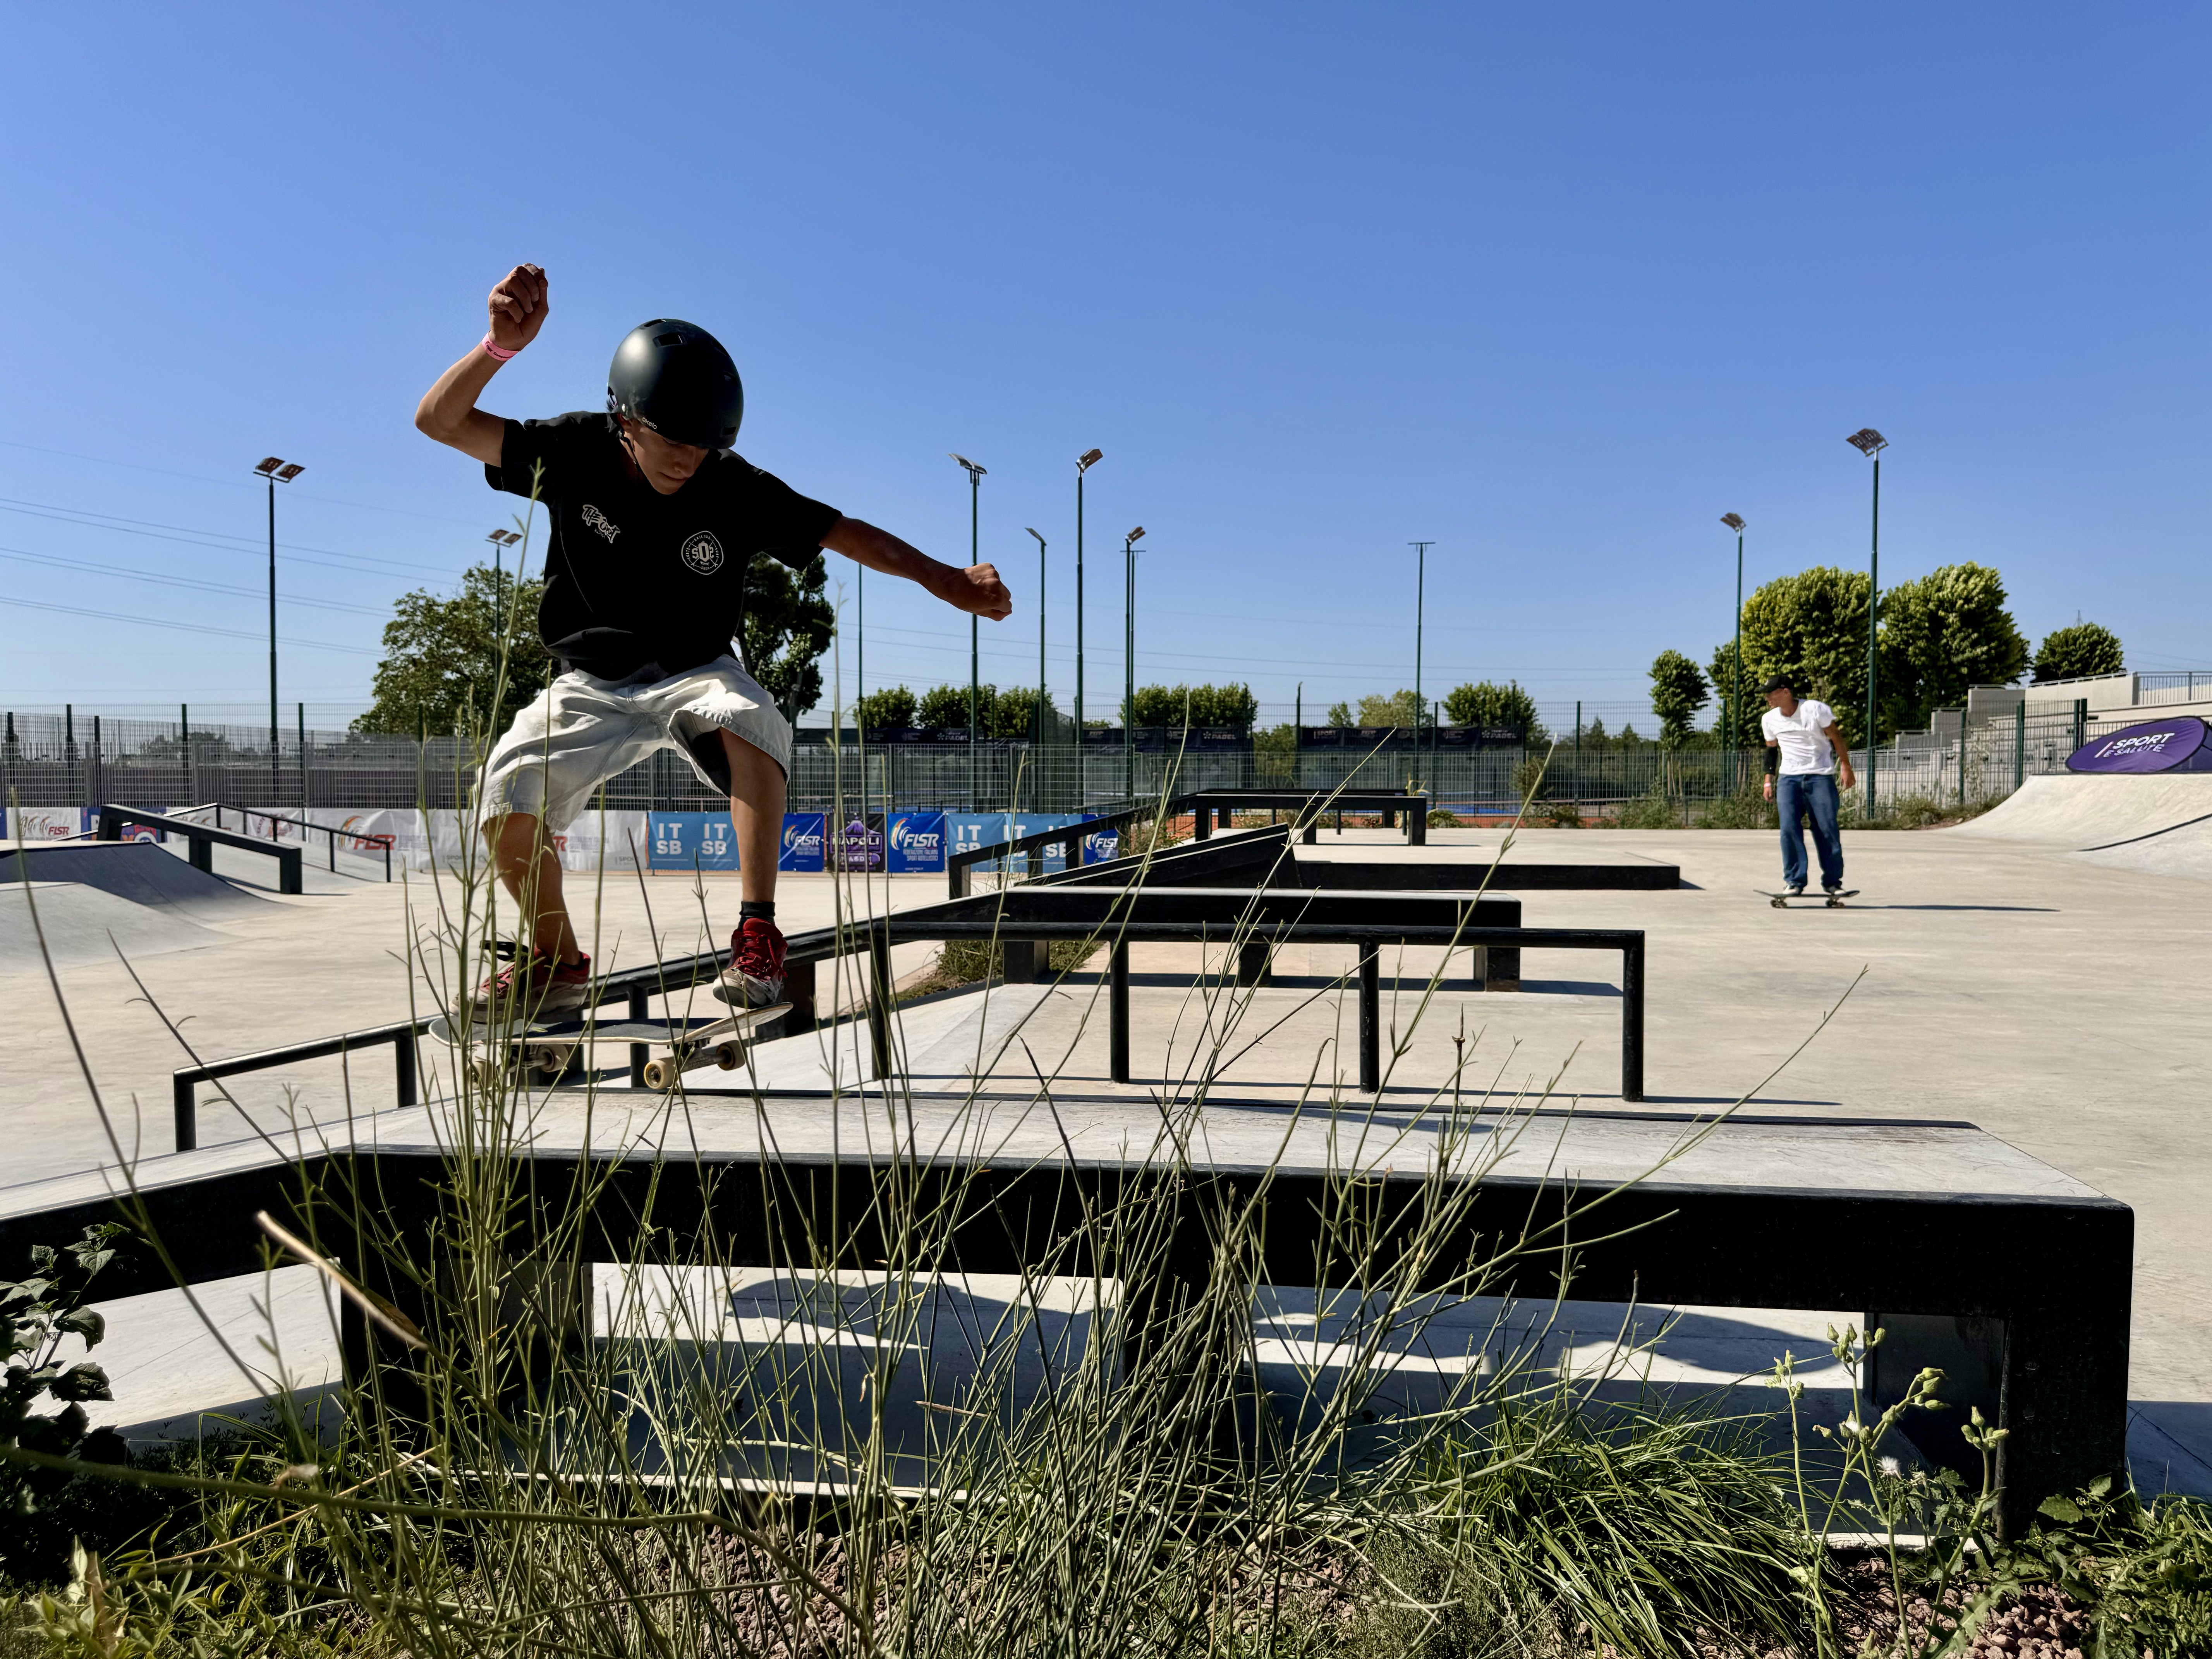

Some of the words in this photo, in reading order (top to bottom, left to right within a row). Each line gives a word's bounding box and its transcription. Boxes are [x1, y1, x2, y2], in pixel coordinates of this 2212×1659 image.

[582, 504, 603, 526] THE
[2113, 733, 2175, 749] SPORT
[2114, 744, 2165, 756] SALUTE
[48, 826, 69, 835] FISR
[659, 823, 682, 839] IT
[704, 823, 727, 839] IT
[958, 825, 981, 841] IT
[1004, 825, 1026, 841] IT
[656, 840, 682, 855] SB
[702, 840, 727, 855] SB
[833, 837, 879, 845] NAPOLI
[903, 833, 939, 847] FISR
